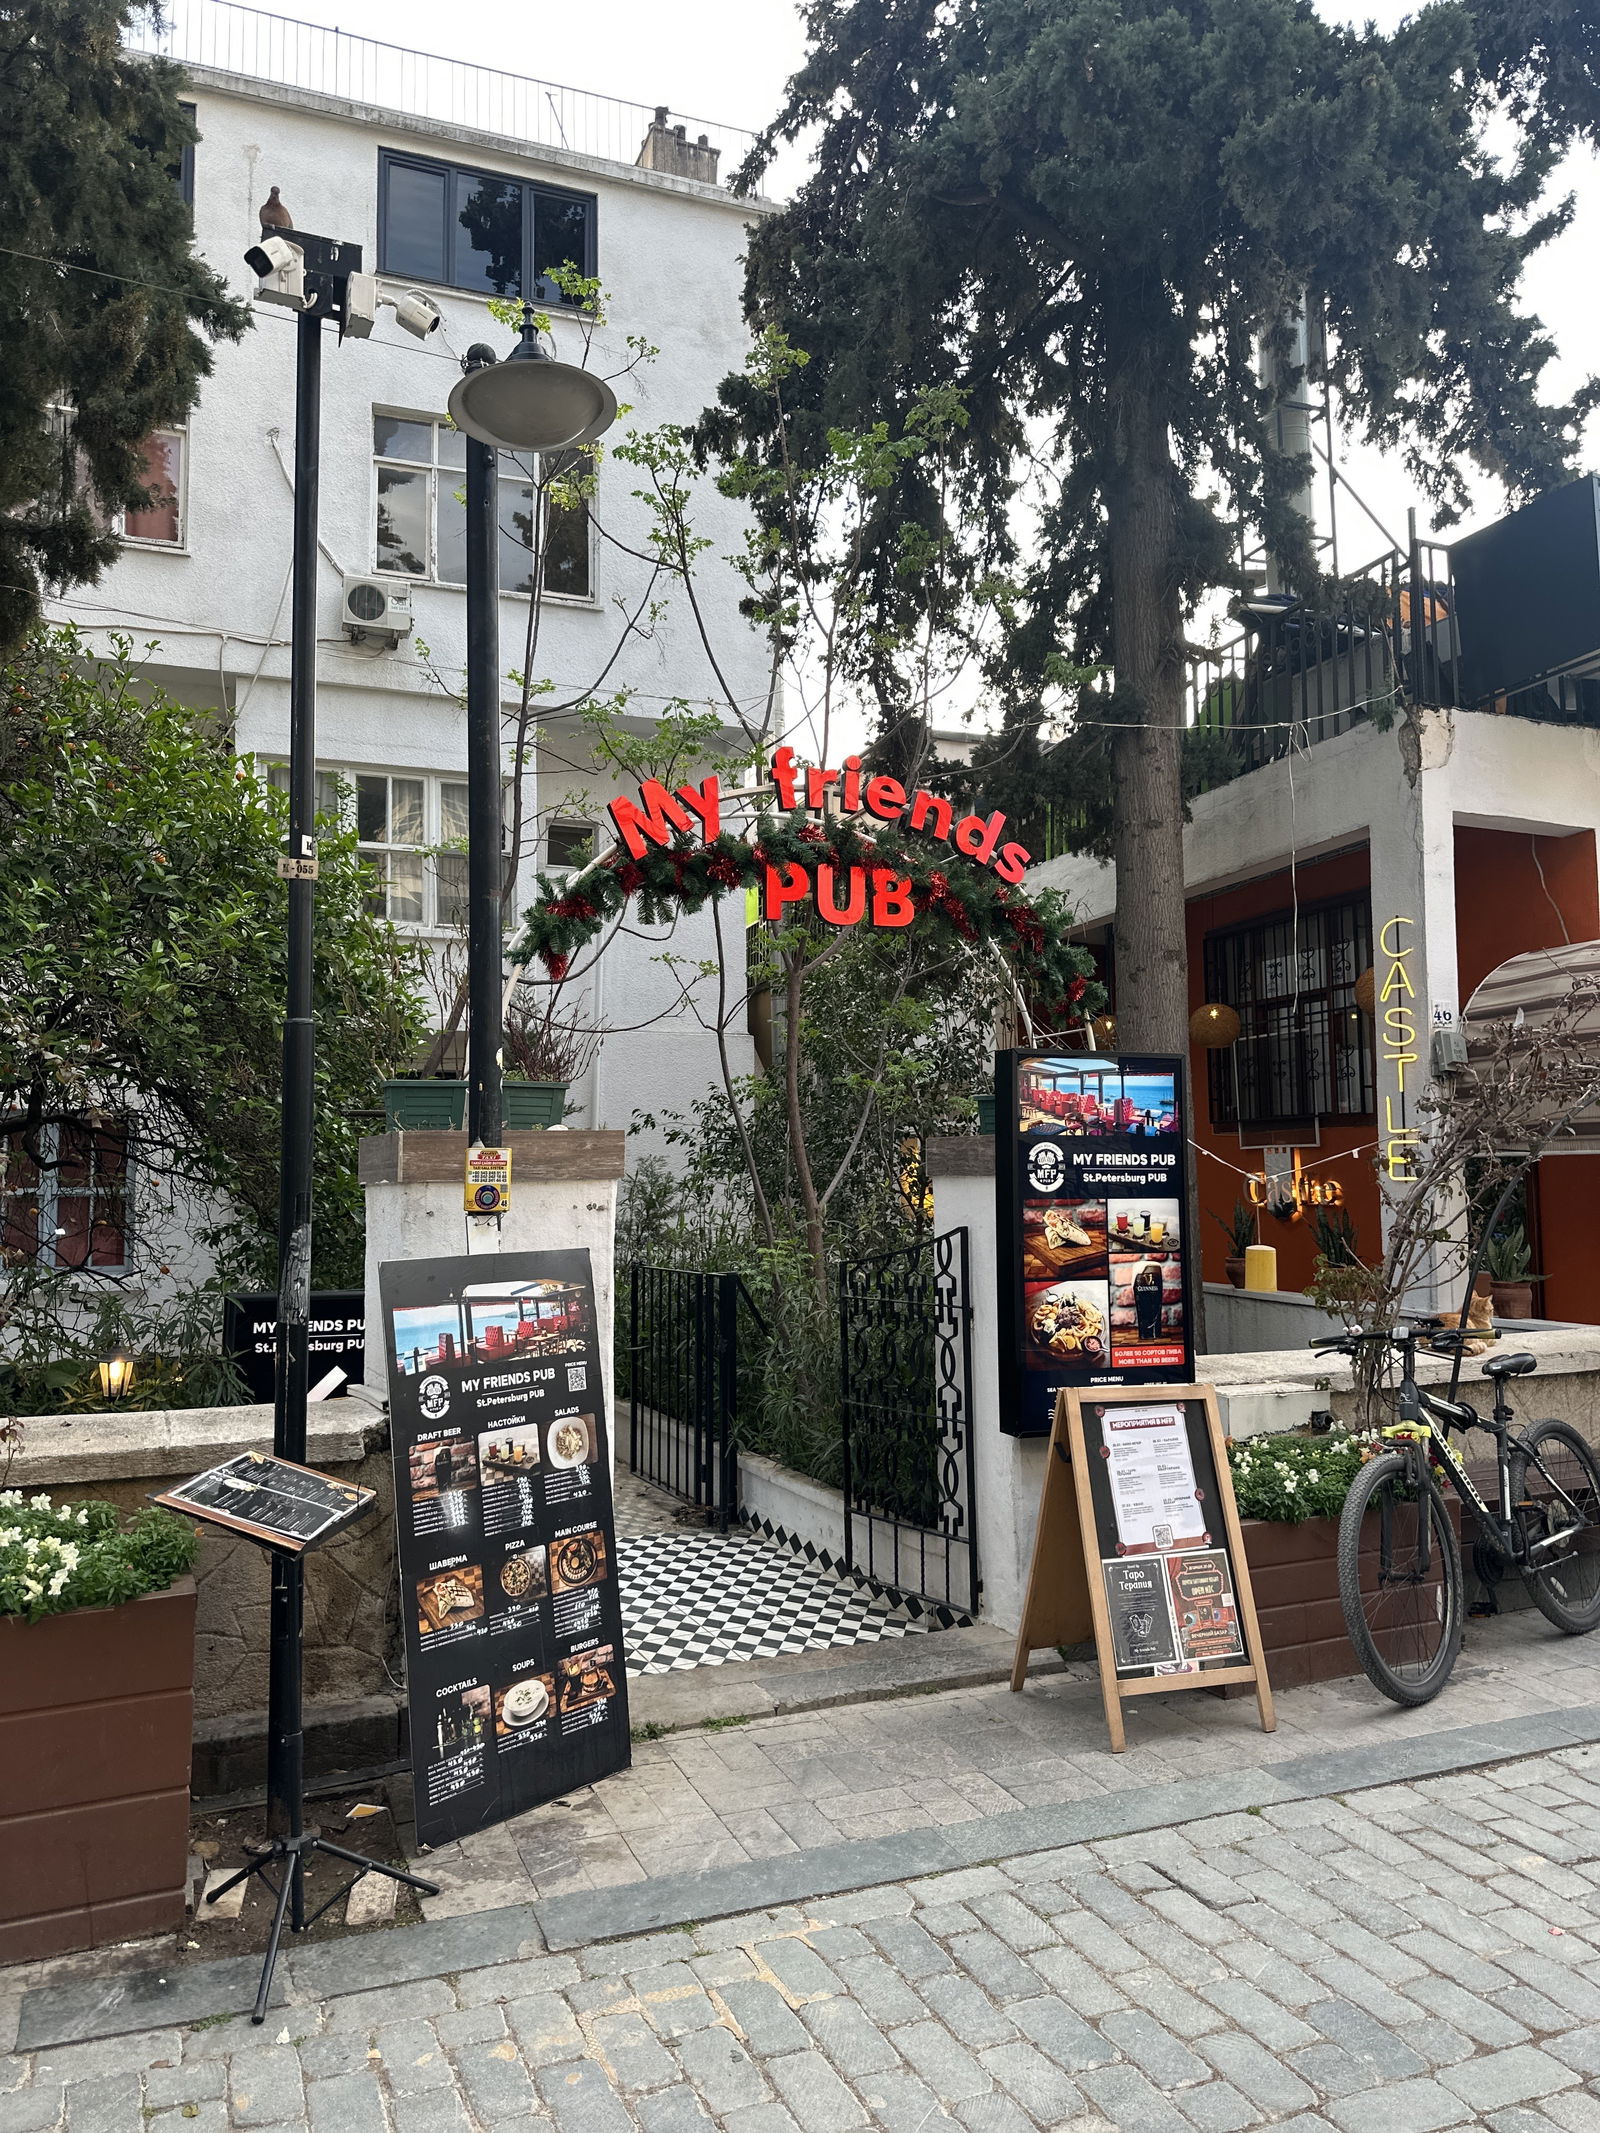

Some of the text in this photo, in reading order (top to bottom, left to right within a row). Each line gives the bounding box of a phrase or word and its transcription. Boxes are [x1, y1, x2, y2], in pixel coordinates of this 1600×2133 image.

[607, 746, 1031, 884] My friends
[763, 861, 915, 927] PUB
[1433, 1009, 1452, 1021] 46
[1380, 917, 1419, 1182] CASTLE
[1072, 1153, 1176, 1166] MY FRIENDS PUB
[1037, 1168, 1057, 1179] MFP
[1083, 1172, 1168, 1184] St.Petersburg PUB
[252, 1321, 277, 1334] MY
[347, 1319, 365, 1331] PU
[347, 1338, 365, 1350] PU
[461, 1377, 481, 1393] MY
[482, 1372, 531, 1390] FRIENDS
[532, 1367, 556, 1382] PUB
[1107, 1375, 1124, 1383] MENU
[476, 1389, 545, 1408] St.Petersburg PUB
[554, 1406, 580, 1417] SALADS
[487, 1414, 526, 1429] НАСТОЙКИ
[1112, 1418, 1156, 1429] МЕРОПРИЯТИЯ
[417, 1427, 462, 1442] DRAFT BEER
[554, 1521, 598, 1538] MAIN COURSE
[504, 1540, 526, 1551] PIZZA
[428, 1554, 468, 1571] ШАВЕРМА
[1122, 1570, 1145, 1581] Таро
[1118, 1580, 1153, 1591] Терапия
[570, 1637, 599, 1653] BURGERS
[511, 1658, 535, 1672] SOUPS
[435, 1677, 478, 1698] COCKTAILS
